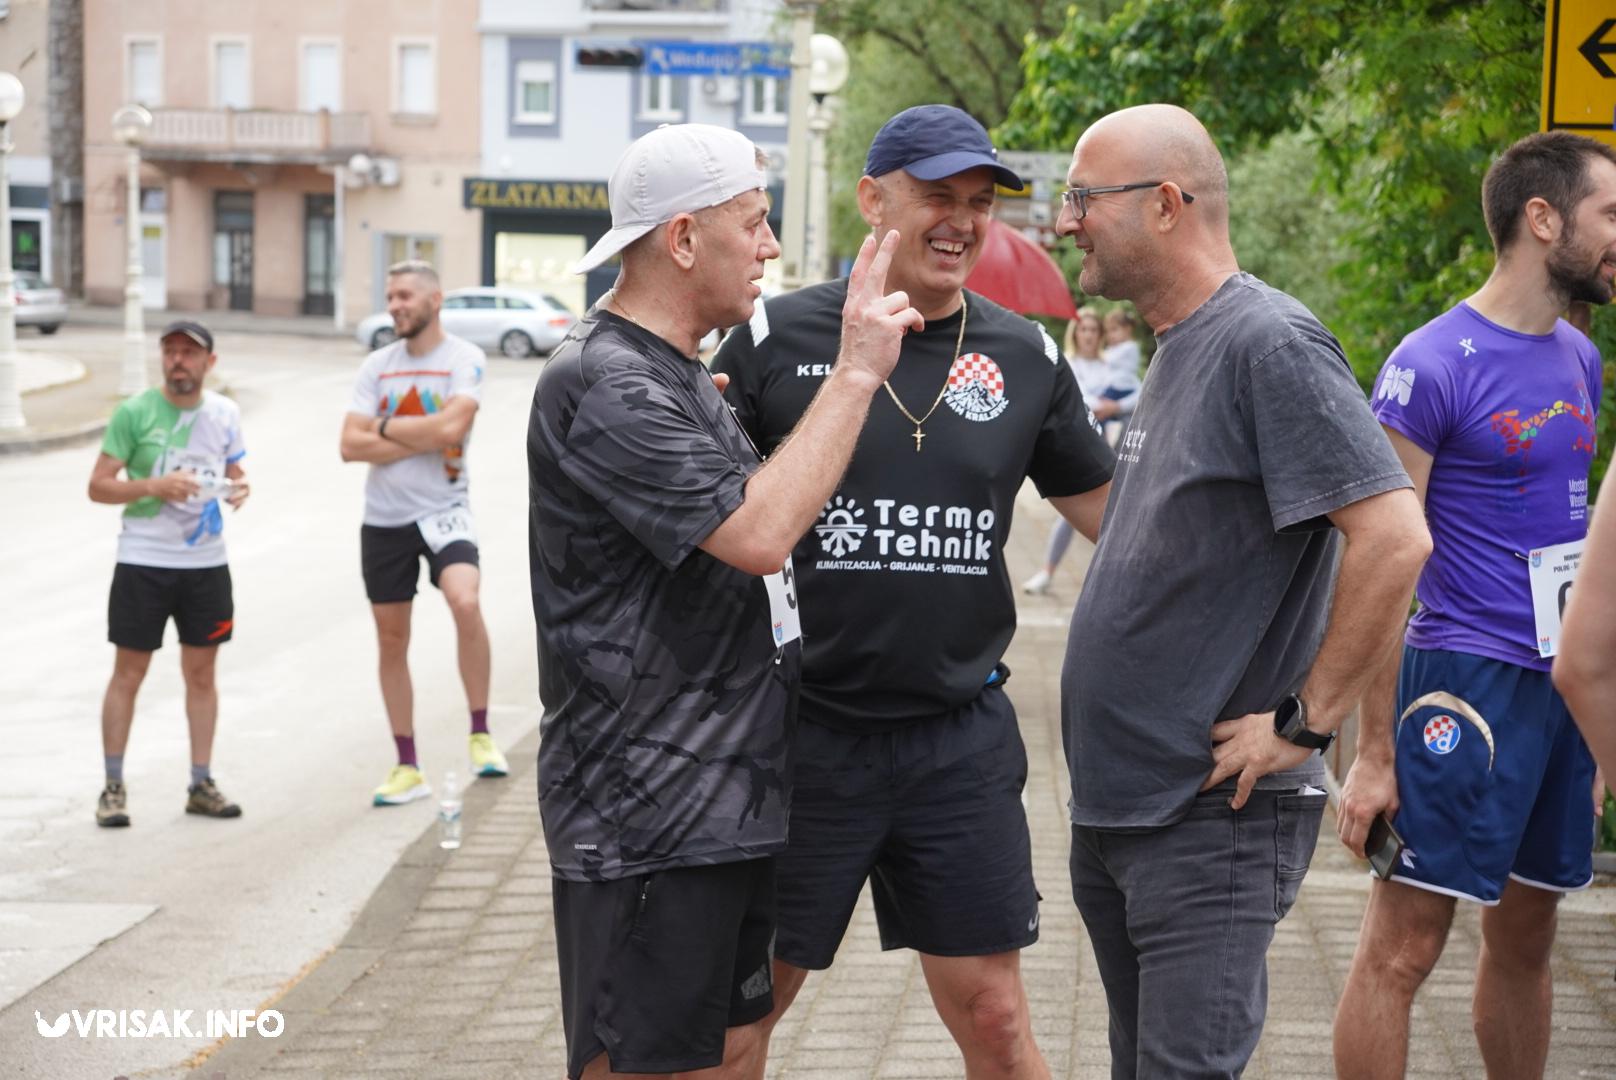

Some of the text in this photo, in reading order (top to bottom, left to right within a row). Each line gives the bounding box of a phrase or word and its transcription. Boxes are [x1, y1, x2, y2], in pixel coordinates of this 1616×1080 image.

[470, 182, 610, 210] ZLATARNA
[873, 499, 995, 531] Termo
[873, 528, 992, 560] Tehnik
[816, 560, 882, 570] KLIMATIZACIJA
[889, 562, 935, 572] GRIJANJE
[942, 564, 988, 576] VENTILACIJA
